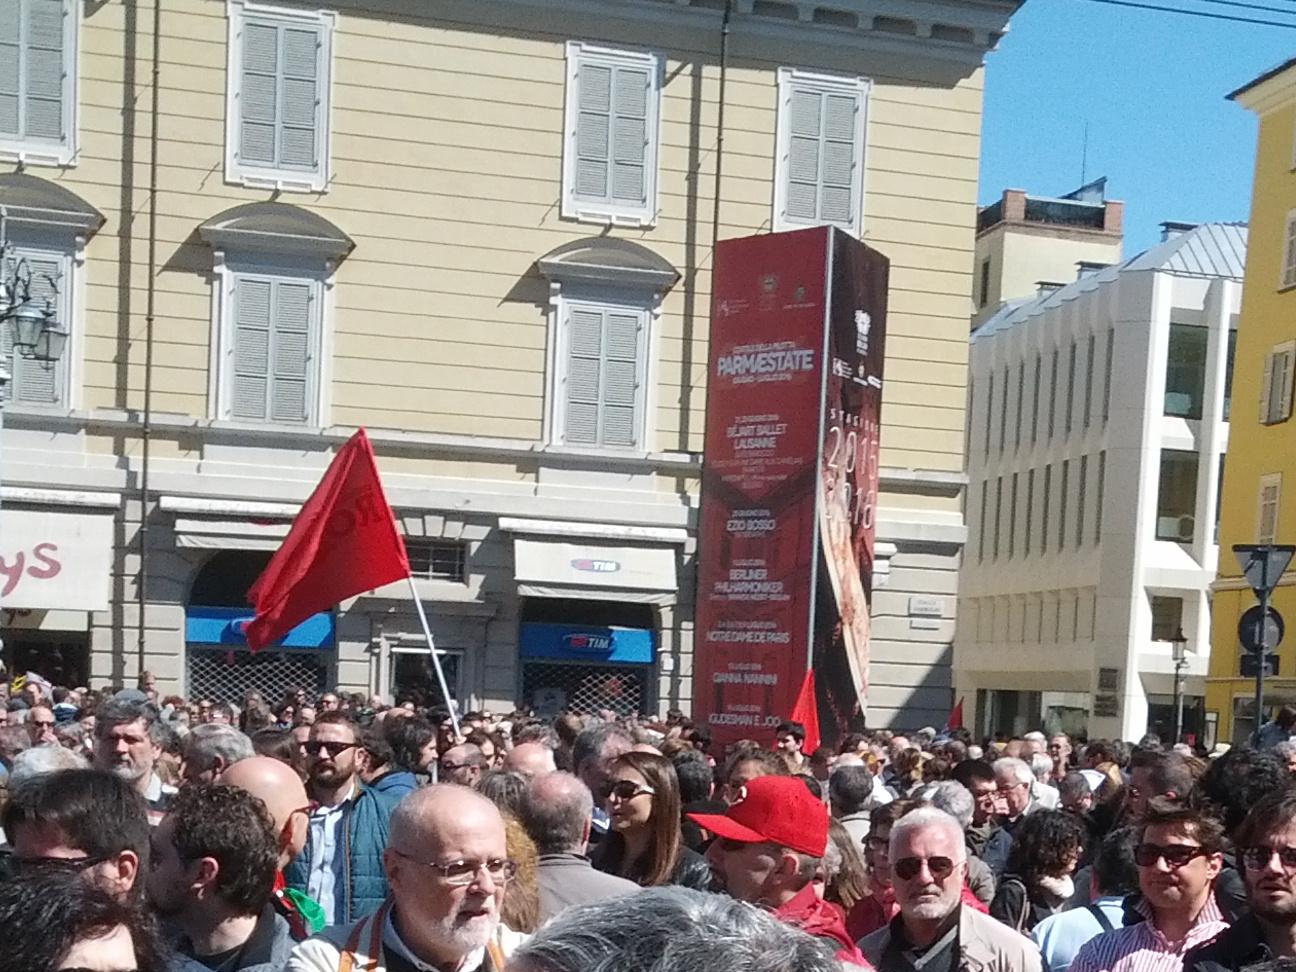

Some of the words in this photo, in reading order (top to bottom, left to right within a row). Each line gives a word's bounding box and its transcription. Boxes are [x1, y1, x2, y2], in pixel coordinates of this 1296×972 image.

[756, 423, 788, 436] BALLET
[827, 426, 878, 480] 2015
[747, 519, 776, 531] BOSSO
[592, 561, 617, 572] TIM
[588, 638, 609, 649] TIM
